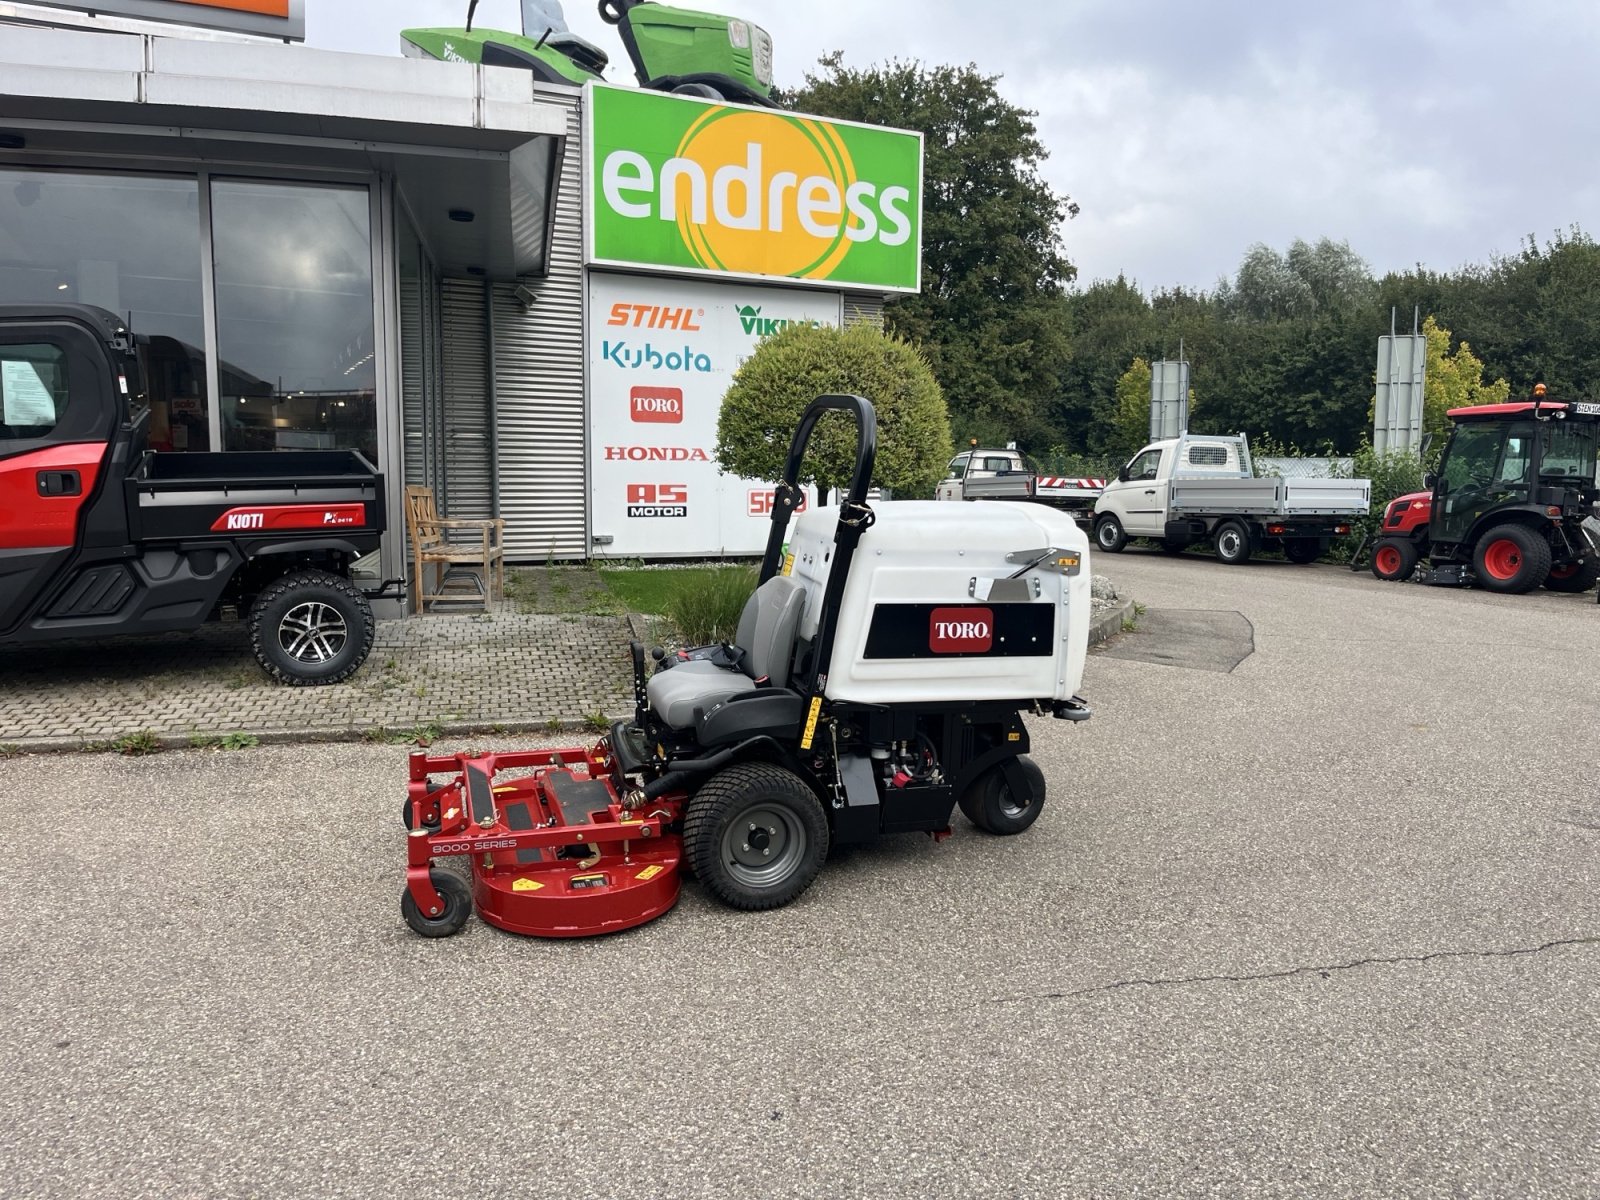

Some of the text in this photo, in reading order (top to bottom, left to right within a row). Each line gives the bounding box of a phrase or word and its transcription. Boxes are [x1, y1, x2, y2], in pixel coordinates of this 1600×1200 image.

[601, 142, 912, 247] endress
[602, 340, 711, 372] Kubota
[632, 397, 679, 412] TORO
[604, 446, 710, 461] HONDA
[627, 484, 687, 503] AS
[630, 507, 684, 516] MOTOR
[227, 513, 264, 529] KIOTI
[935, 621, 989, 639] TORO
[432, 839, 518, 854] 8000 SERIES
